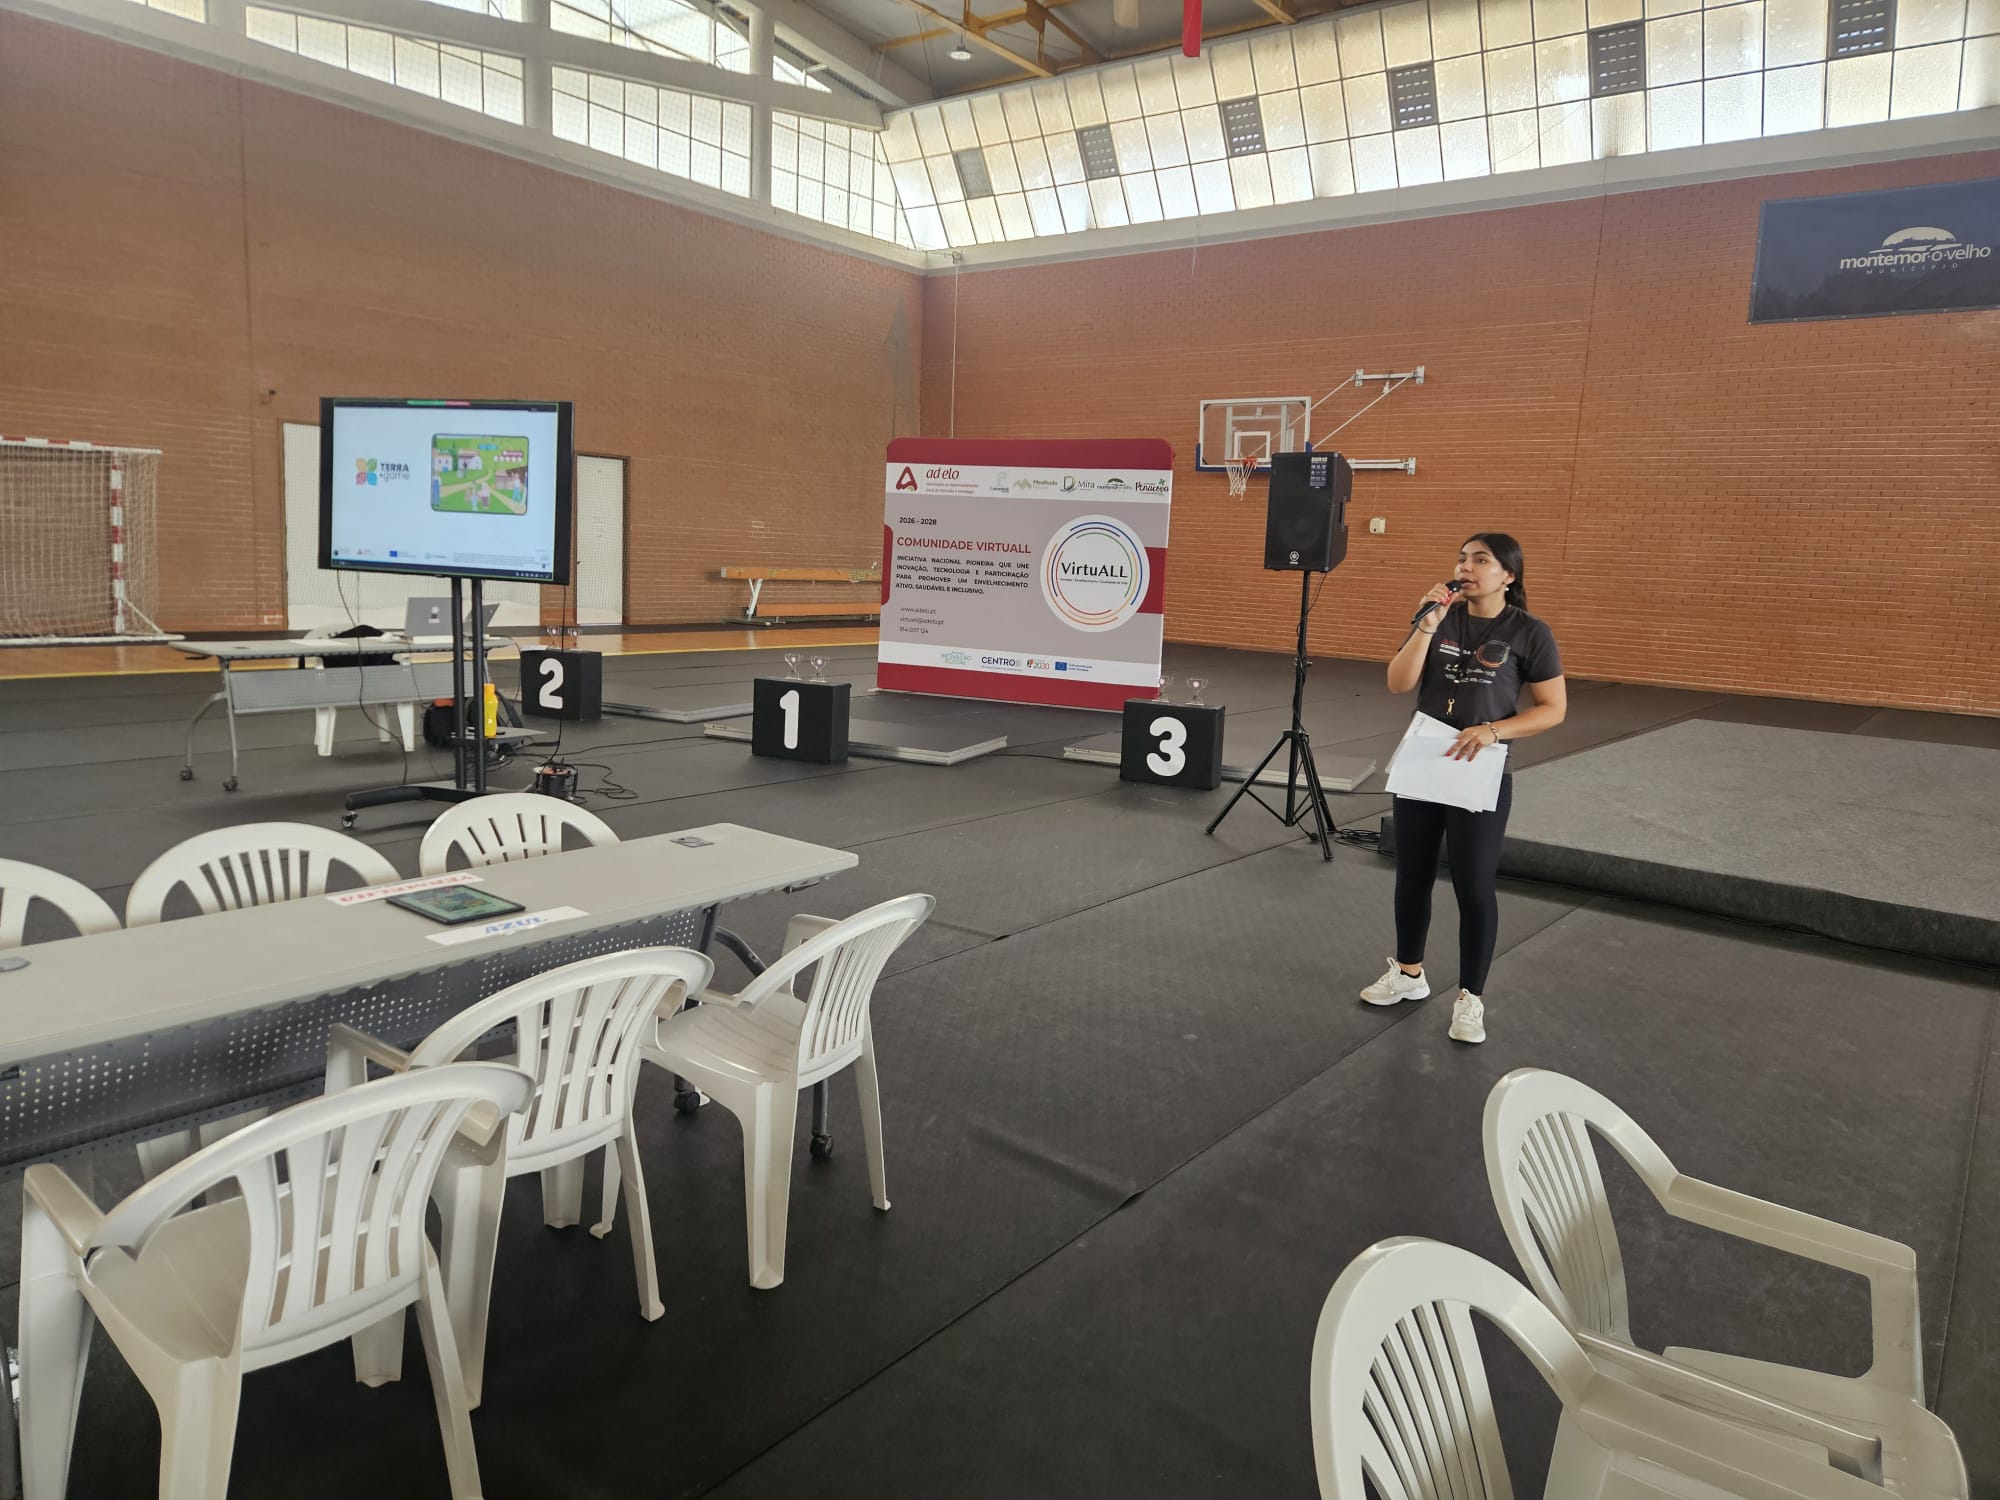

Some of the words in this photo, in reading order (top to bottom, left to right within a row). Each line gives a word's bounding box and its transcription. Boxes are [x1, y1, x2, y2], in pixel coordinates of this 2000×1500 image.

[380, 463, 409, 472] TERRA
[1078, 479, 1095, 489] Mira
[899, 517, 915, 525] 2026
[920, 518, 937, 526] 2028
[897, 536, 974, 551] COMUNIDADE
[976, 541, 1031, 554] VIRTUALL
[931, 557, 961, 565] NACIONAL
[933, 566, 970, 575] TECNOLOGIA
[984, 570, 1030, 580] PARTICIPAÇÃO
[1061, 561, 1129, 578] VirtuALL
[895, 582, 914, 590] ATIVO,
[915, 584, 945, 592] SAUDÁVEL
[918, 575, 951, 583] PROMOVER
[974, 579, 1029, 588] ENVELHECIMENTO
[981, 656, 1016, 667] CENTRO
[539, 657, 564, 710] 2
[779, 689, 800, 750] 1
[1146, 716, 1188, 777] 3
